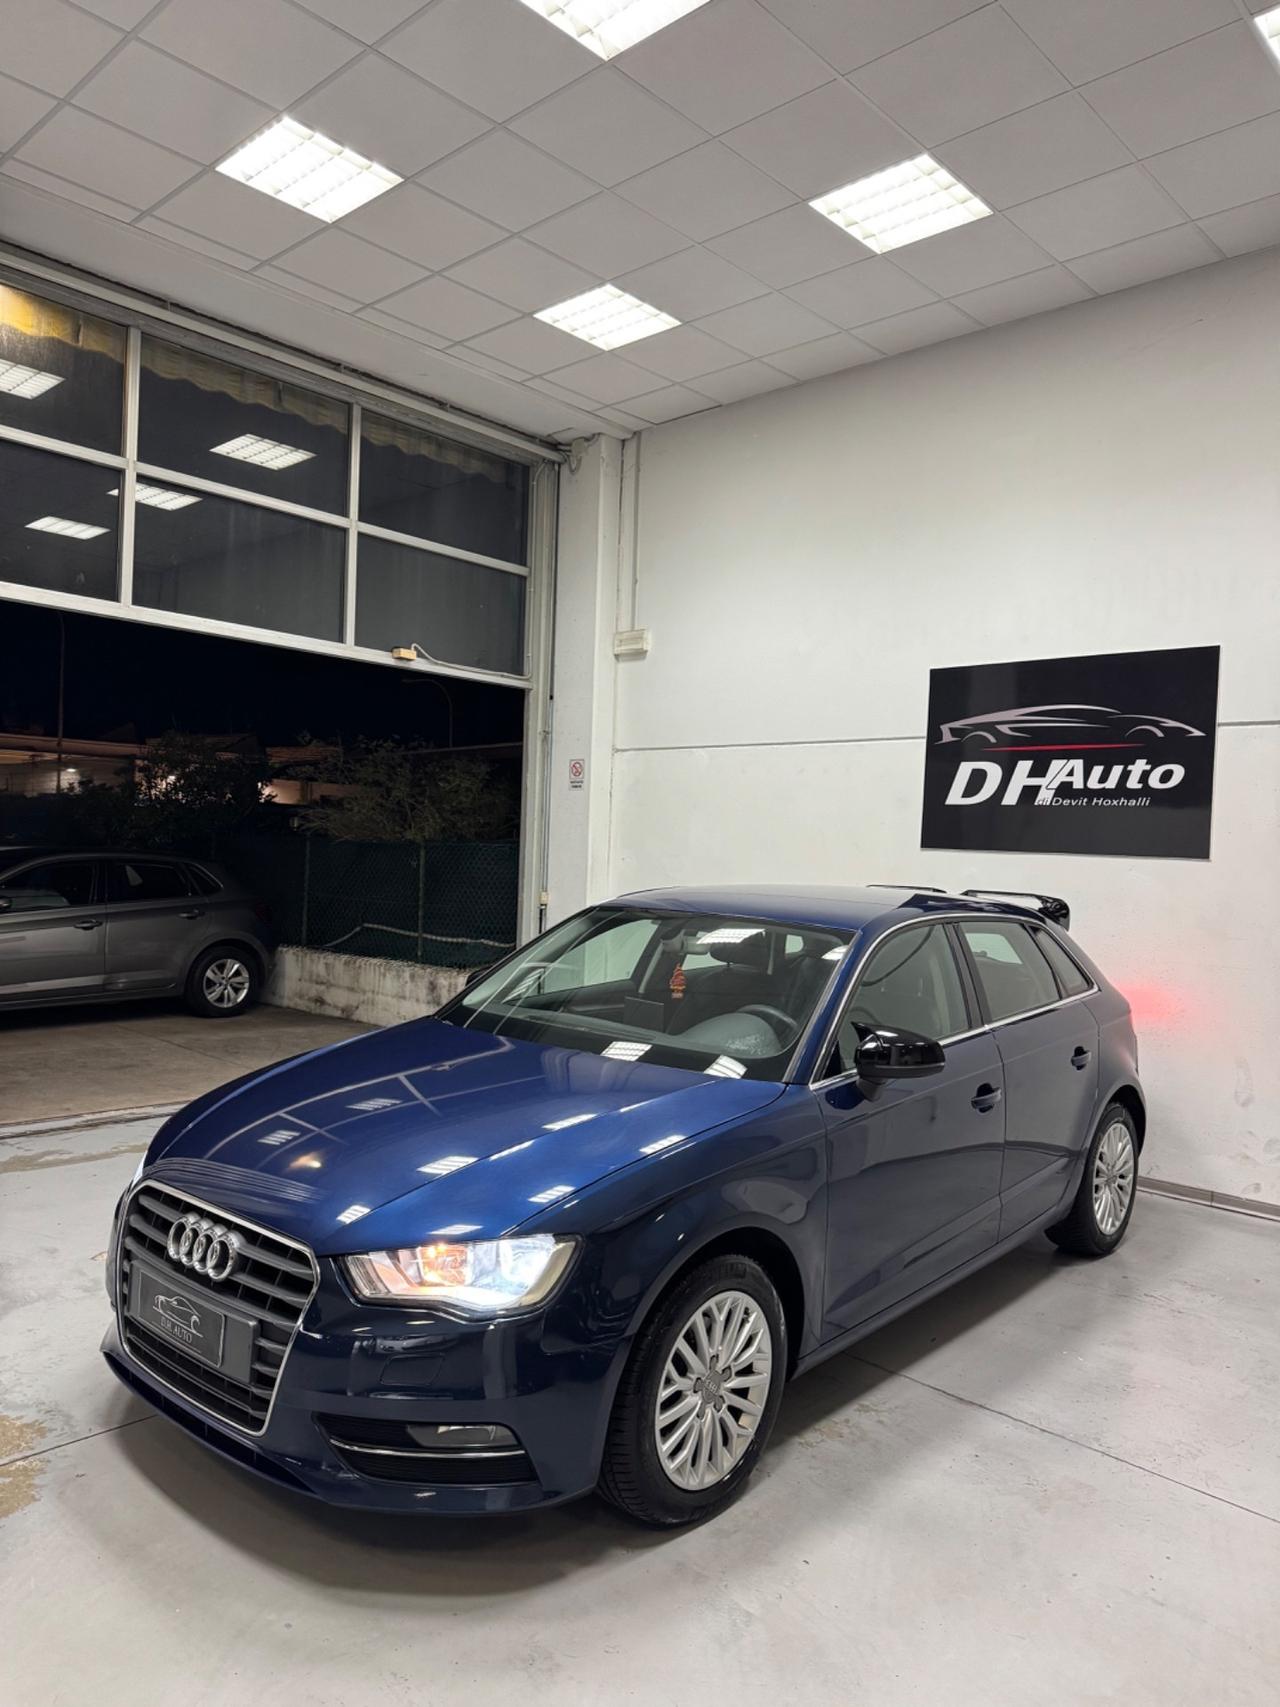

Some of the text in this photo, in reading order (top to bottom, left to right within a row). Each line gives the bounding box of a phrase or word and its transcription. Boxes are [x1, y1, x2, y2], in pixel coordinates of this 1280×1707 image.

[1052, 797, 1088, 806] Devit
[1092, 797, 1151, 806] Hoxhalli
[173, 1325, 192, 1343] AUTO
